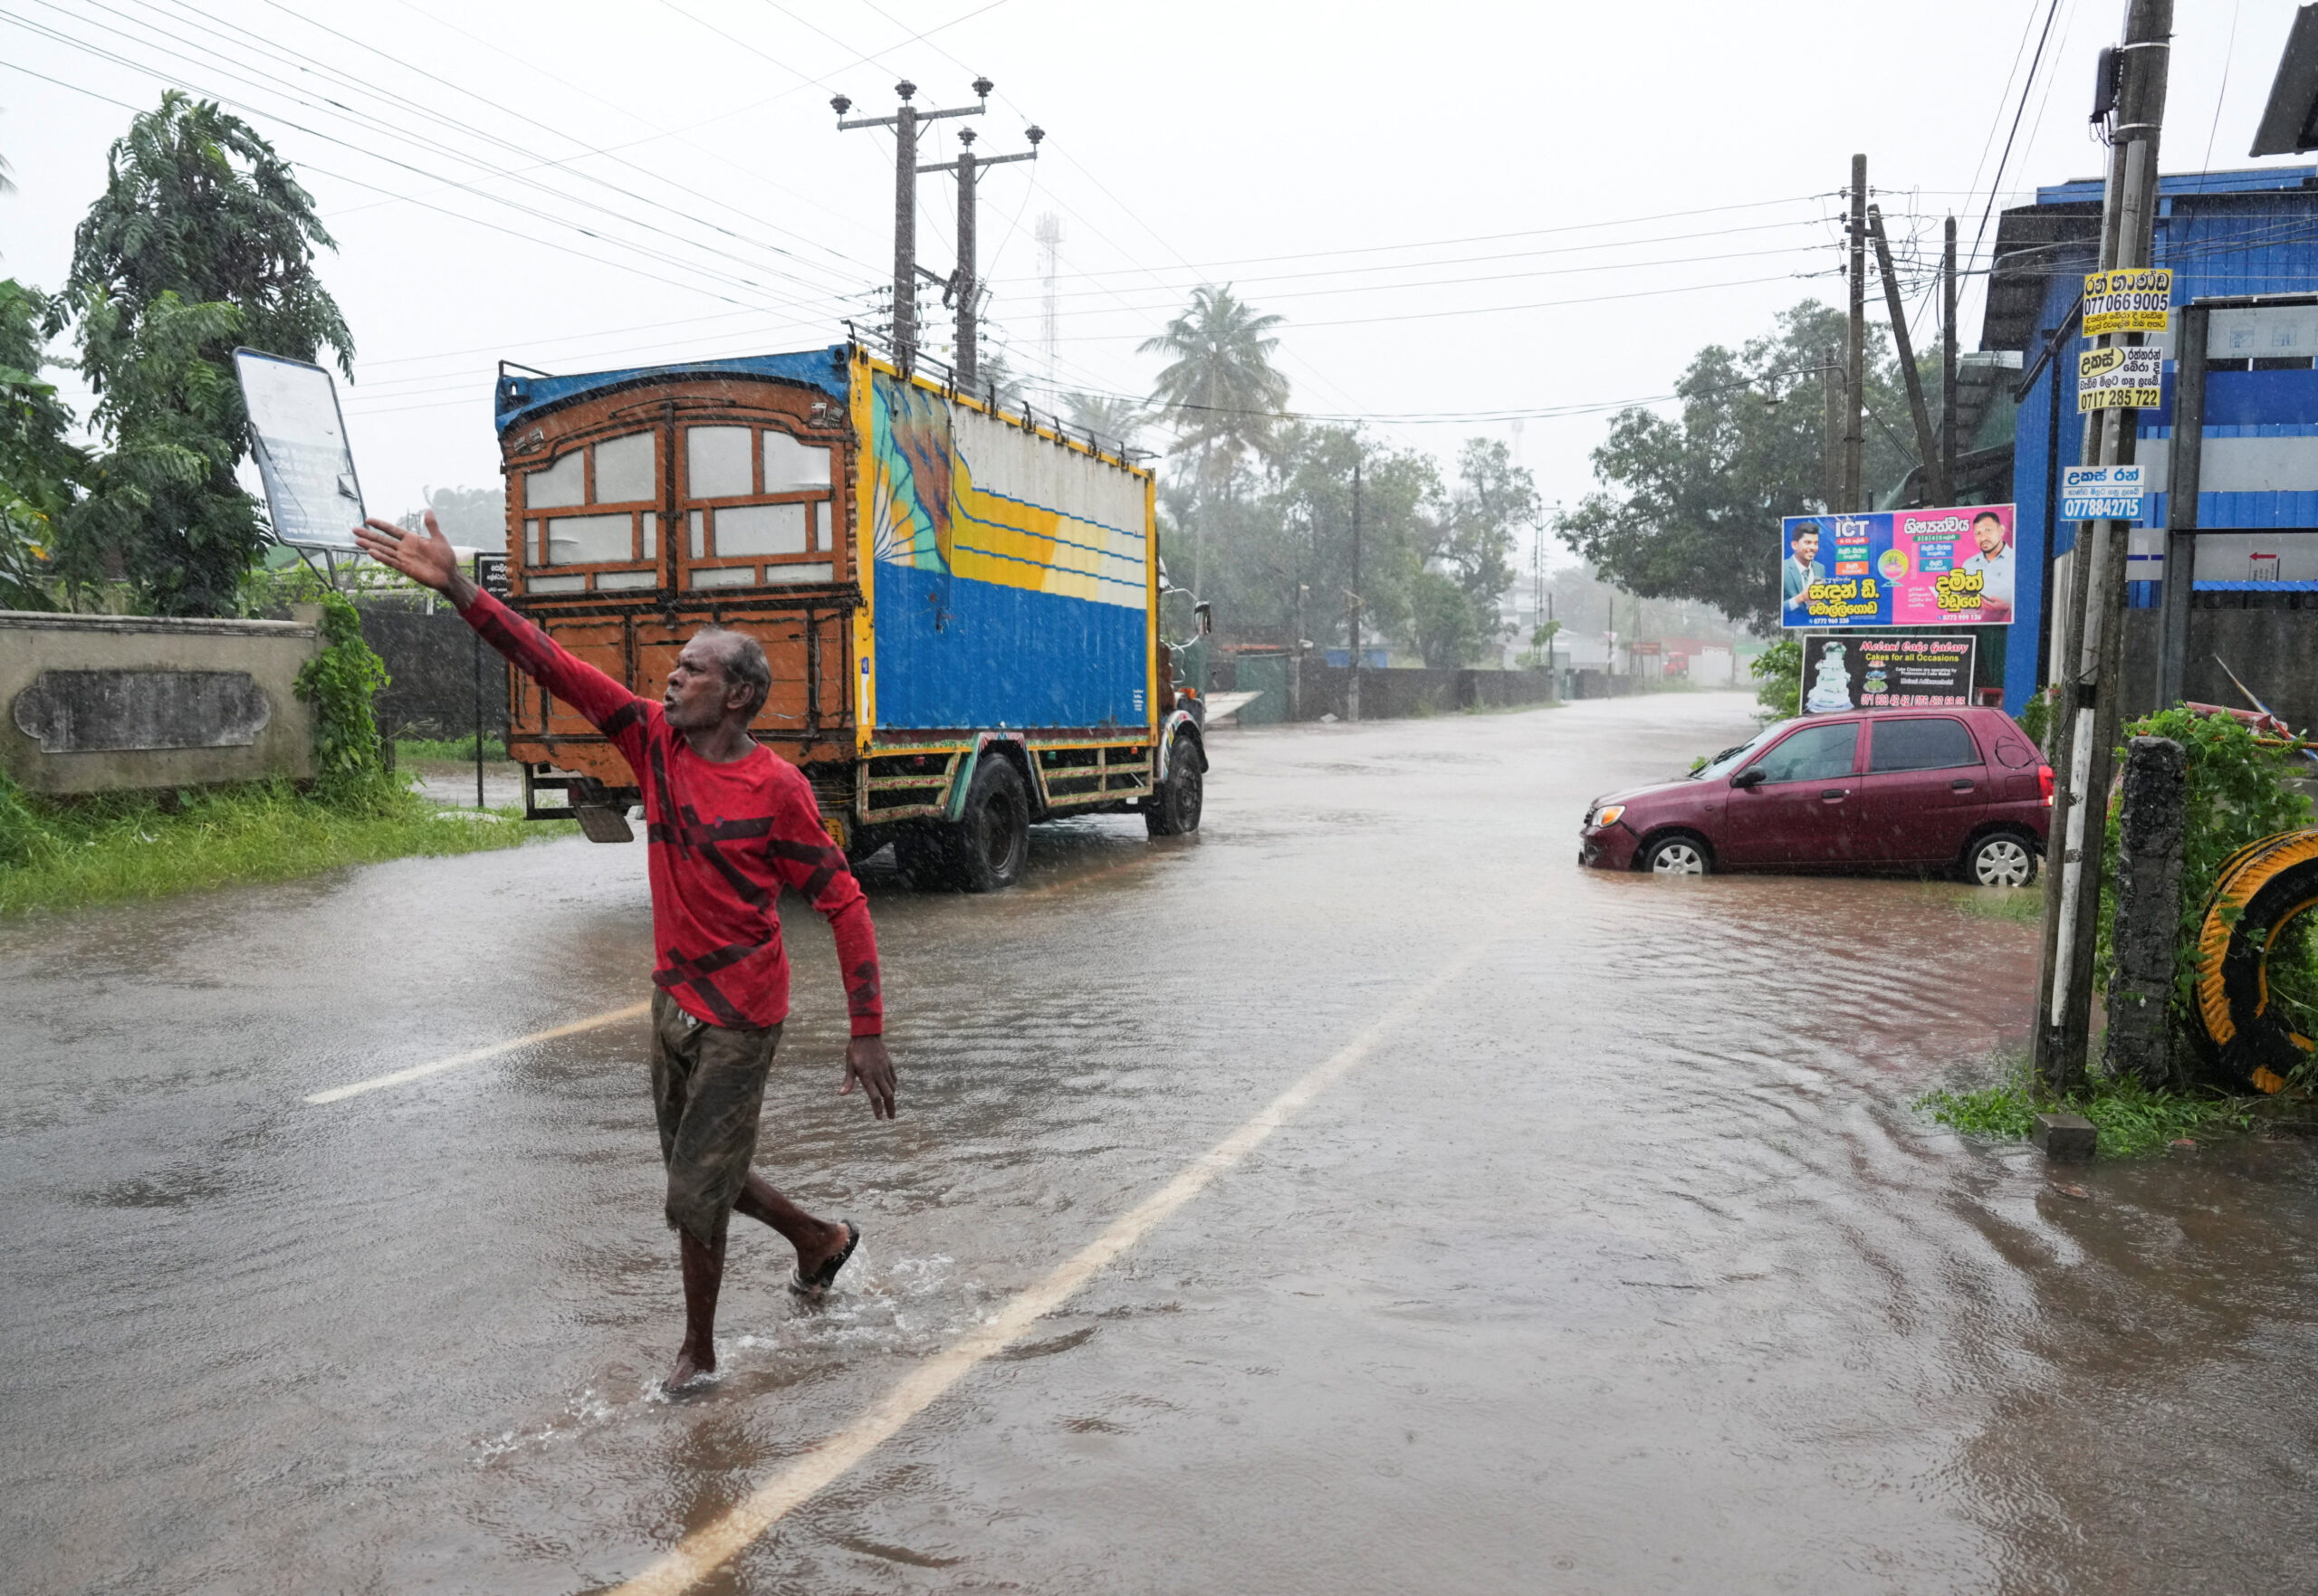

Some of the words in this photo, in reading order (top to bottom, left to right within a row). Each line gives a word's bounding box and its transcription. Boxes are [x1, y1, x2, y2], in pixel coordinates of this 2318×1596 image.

[2086, 272, 2108, 295] රන්
[2112, 271, 2169, 291] භාණ්ඩ
[2084, 296, 2104, 315] 077
[2106, 293, 2131, 311] 066
[2133, 293, 2168, 311] 9005
[2082, 349, 2114, 375] උකස්
[2123, 361, 2149, 372] බේරා
[2080, 377, 2097, 390] වැඩිම
[2100, 376, 2118, 387] මිලට
[2122, 378, 2135, 387] ගනු
[2138, 376, 2160, 387] ලැබේ.
[2082, 391, 2105, 409] 0717
[2109, 390, 2131, 406] 285
[2136, 390, 2157, 406] 722
[2068, 468, 2107, 485] උකස්
[2114, 468, 2139, 482] රන්
[2064, 499, 2138, 516] 0778842715
[1835, 521, 1869, 537] ICT
[1936, 568, 1983, 594] දමිත්
[1809, 579, 1857, 604] සඳුන්
[1860, 641, 1900, 652] Melani
[1901, 641, 1928, 652] Cake
[1930, 642, 1968, 654] Galary
[1917, 654, 1959, 662] Occasions
[1861, 693, 1873, 705] 071
[1890, 694, 1900, 706] 42
[1900, 694, 1910, 706] 42
